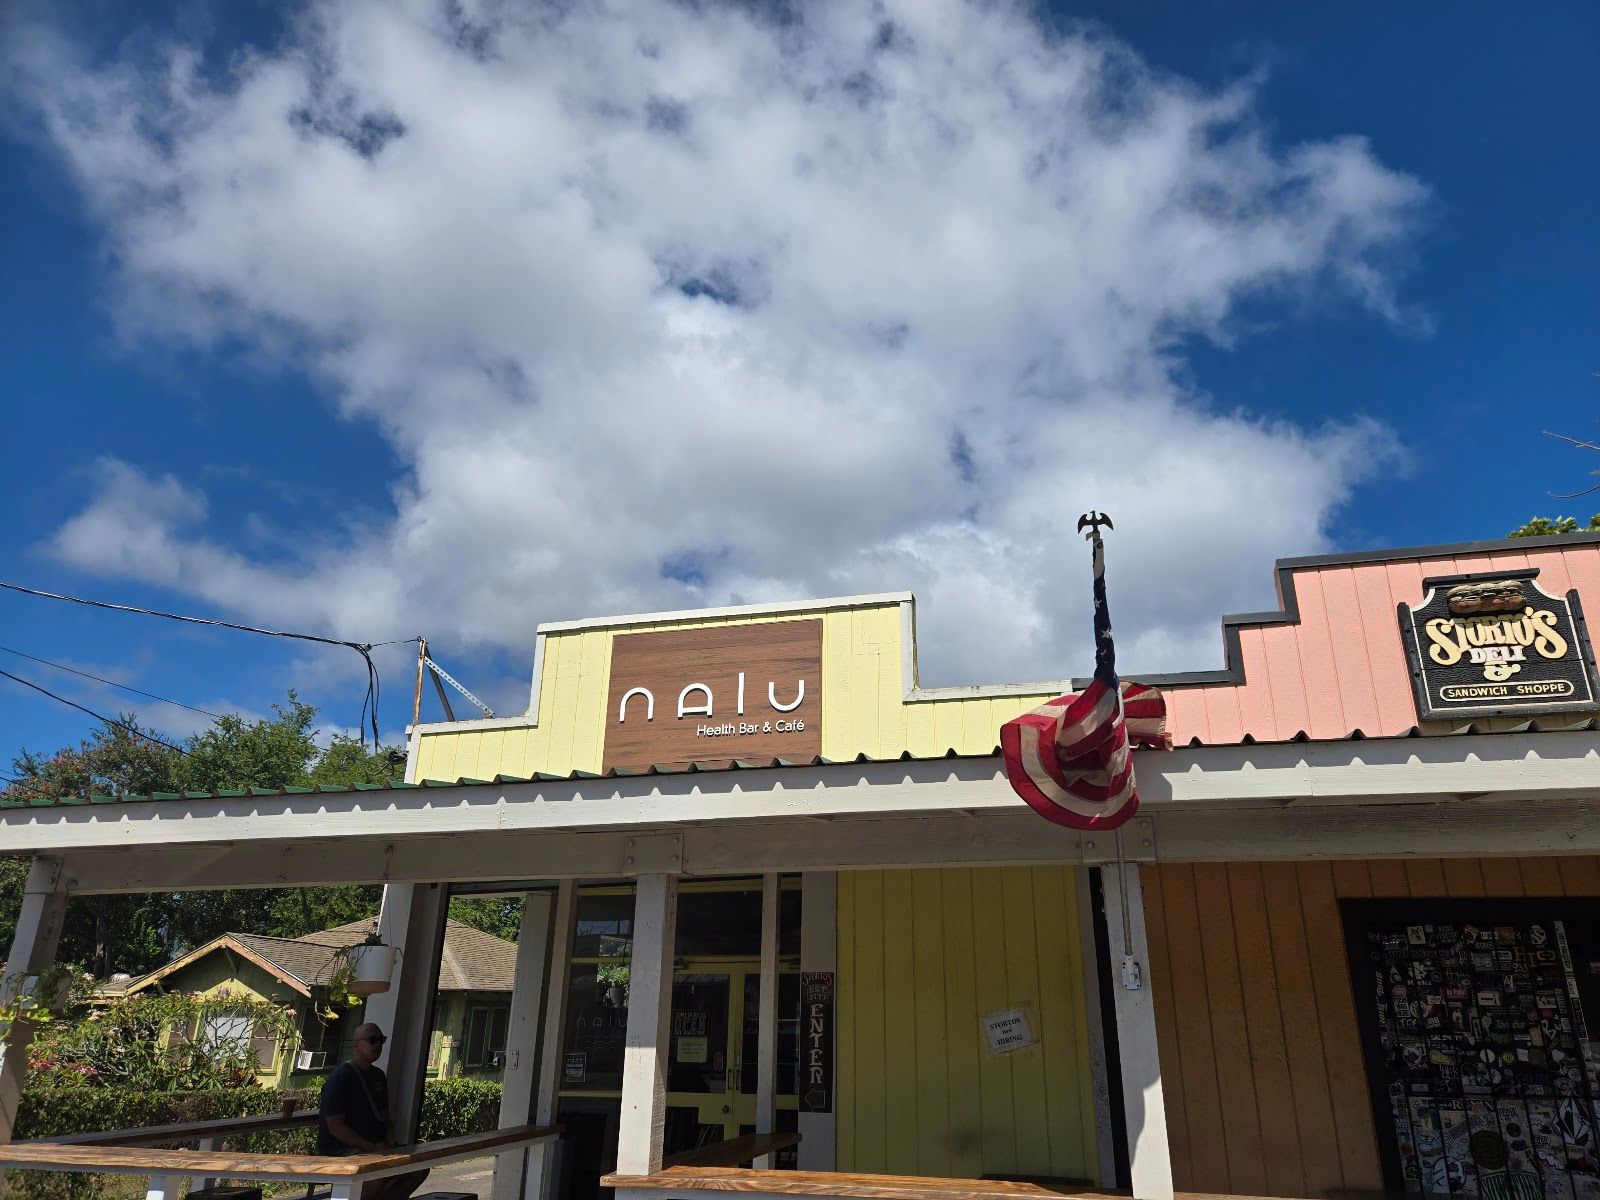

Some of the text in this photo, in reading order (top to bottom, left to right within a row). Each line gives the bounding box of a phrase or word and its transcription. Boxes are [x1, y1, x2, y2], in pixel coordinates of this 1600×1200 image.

[1469, 645, 1527, 664] DELI
[1483, 660, 1521, 682] &
[1448, 683, 1565, 698] SANDWICH SHOPPE
[697, 719, 805, 737] Health Bar & Café
[808, 1003, 824, 1084] ENTER
[997, 1034, 1023, 1046] HIRING
